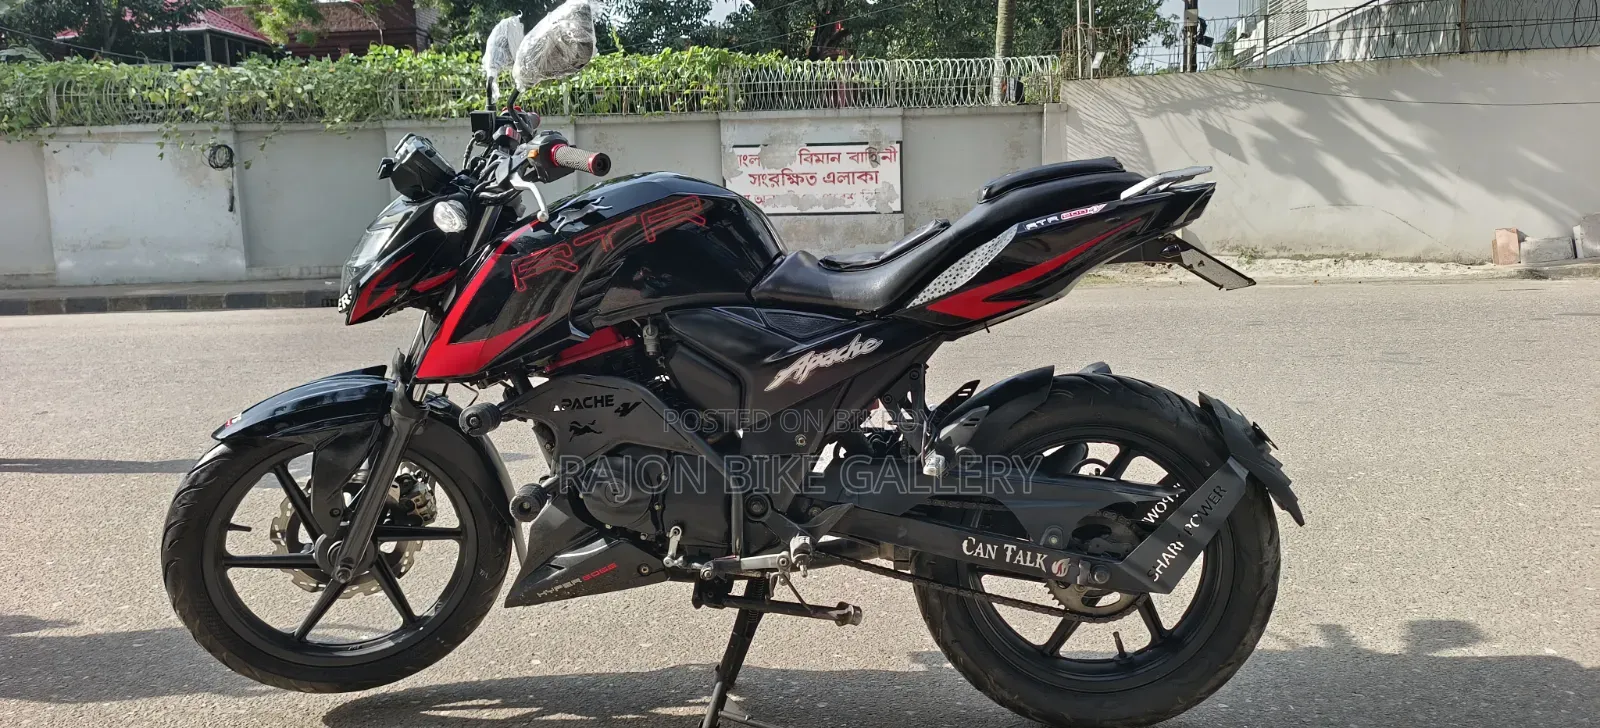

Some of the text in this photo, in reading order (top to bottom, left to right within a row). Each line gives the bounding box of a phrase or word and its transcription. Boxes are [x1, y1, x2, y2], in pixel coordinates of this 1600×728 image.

[748, 168, 880, 187] সংরক্ষিত এলাকা
[798, 147, 841, 166] বিমান
[511, 195, 706, 292] RTR
[764, 333, 884, 391] Apache
[1183, 485, 1227, 537] POWER
